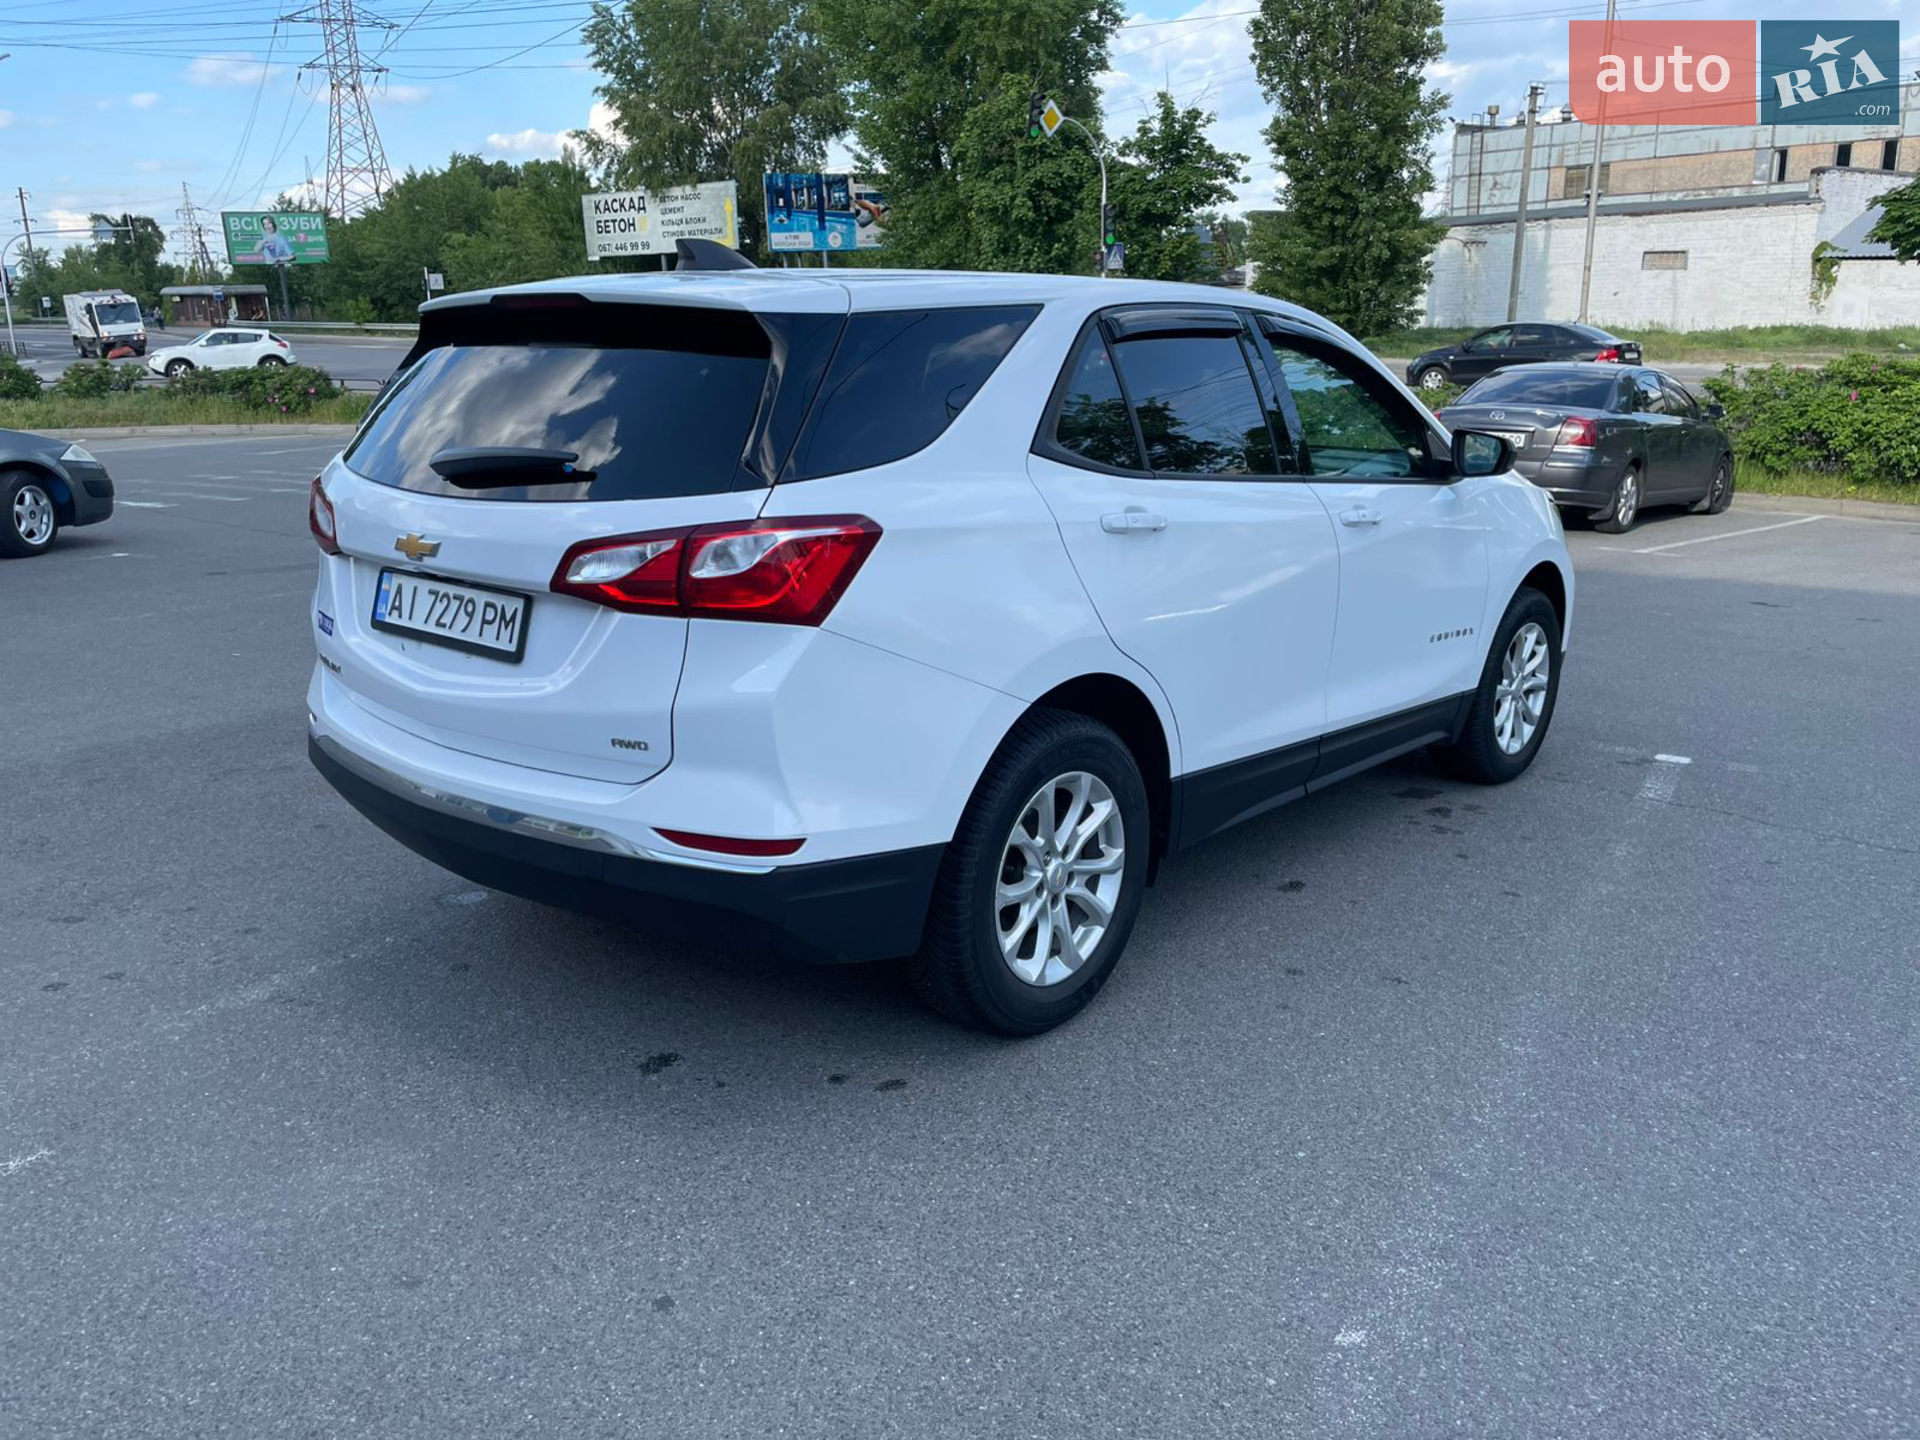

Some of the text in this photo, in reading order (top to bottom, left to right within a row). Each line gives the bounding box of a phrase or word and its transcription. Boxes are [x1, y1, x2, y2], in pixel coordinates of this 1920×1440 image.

[680, 192, 702, 201] НАСОС
[594, 196, 647, 215] КАСКАД
[660, 206, 685, 216] ЦЕМЕНТ
[229, 216, 323, 231] ВСІ ЗУБИ
[596, 216, 637, 235] БЕТОН
[685, 216, 707, 225] БЛОКИ
[687, 228, 723, 236] МАТЕРІАЛИ
[614, 242, 629, 252] 446
[629, 241, 639, 251] 99
[640, 240, 650, 250] 99
[388, 583, 519, 644] AI 7279 PM
